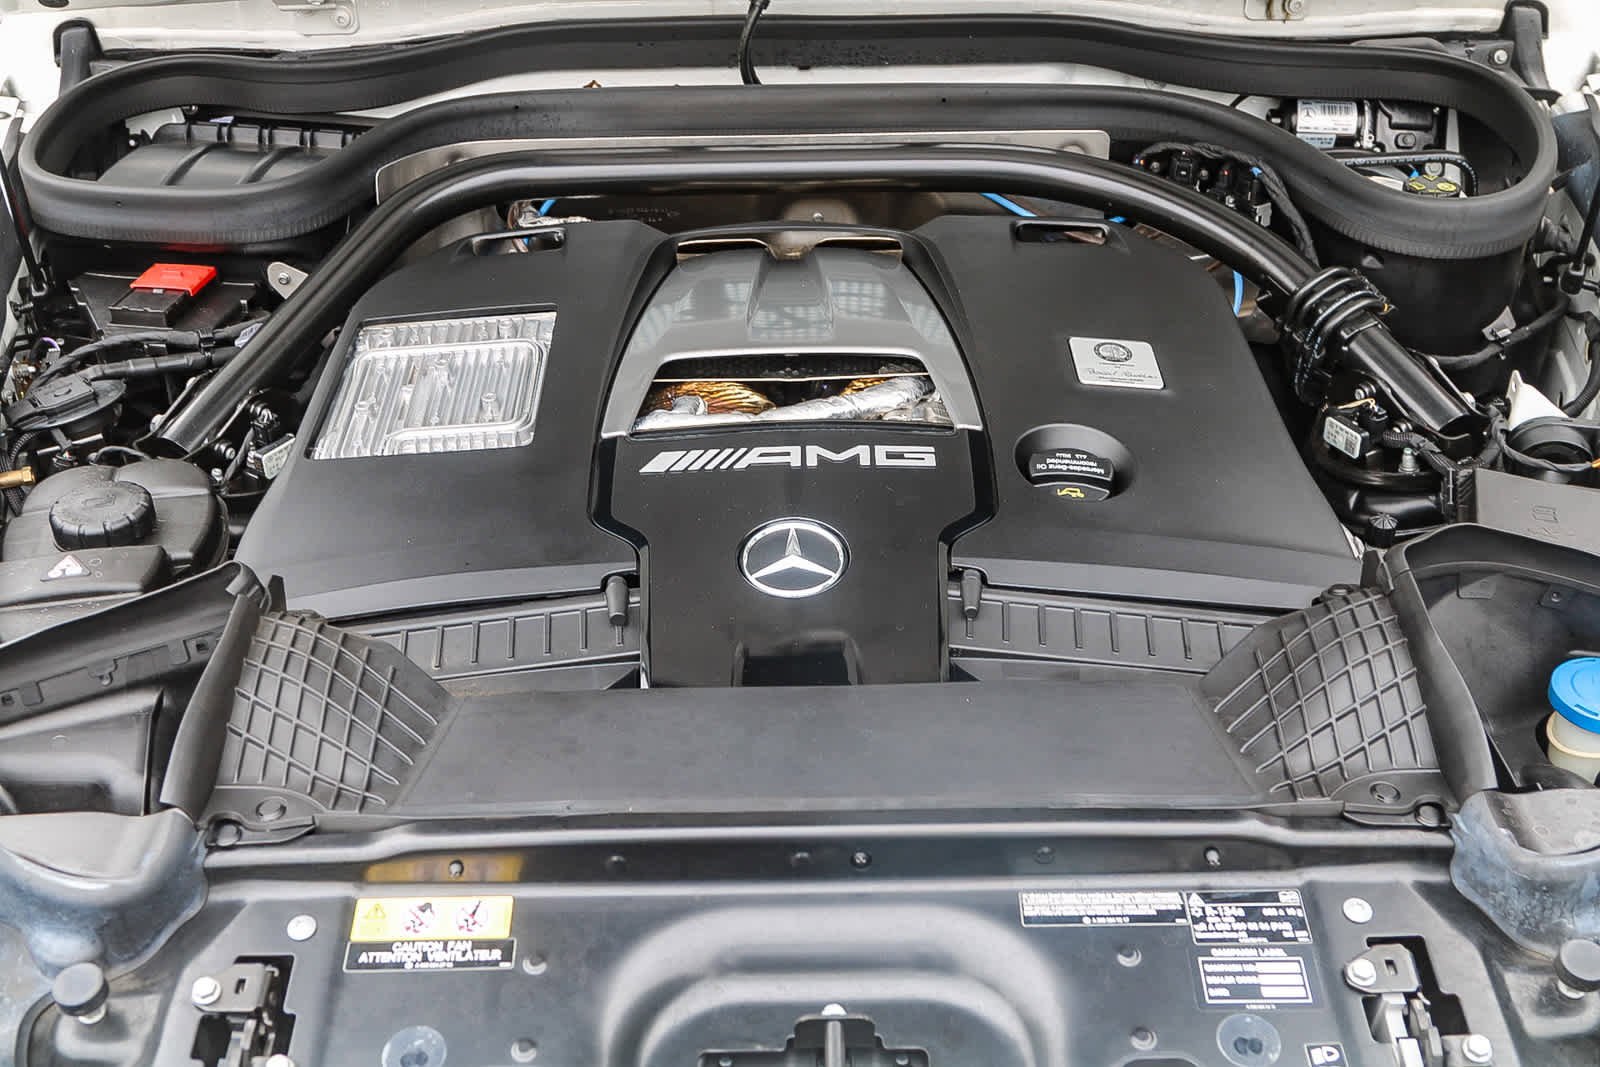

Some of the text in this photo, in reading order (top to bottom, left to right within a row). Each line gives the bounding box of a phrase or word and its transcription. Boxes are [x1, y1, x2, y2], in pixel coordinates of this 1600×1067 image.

[733, 445, 936, 468] AMG
[1046, 458, 1097, 467] recommended
[1048, 464, 1104, 474] Mercedes-Benz
[392, 940, 472, 952] CAUTION FAN
[358, 949, 501, 963] ATTENTION VENTILATEUR
